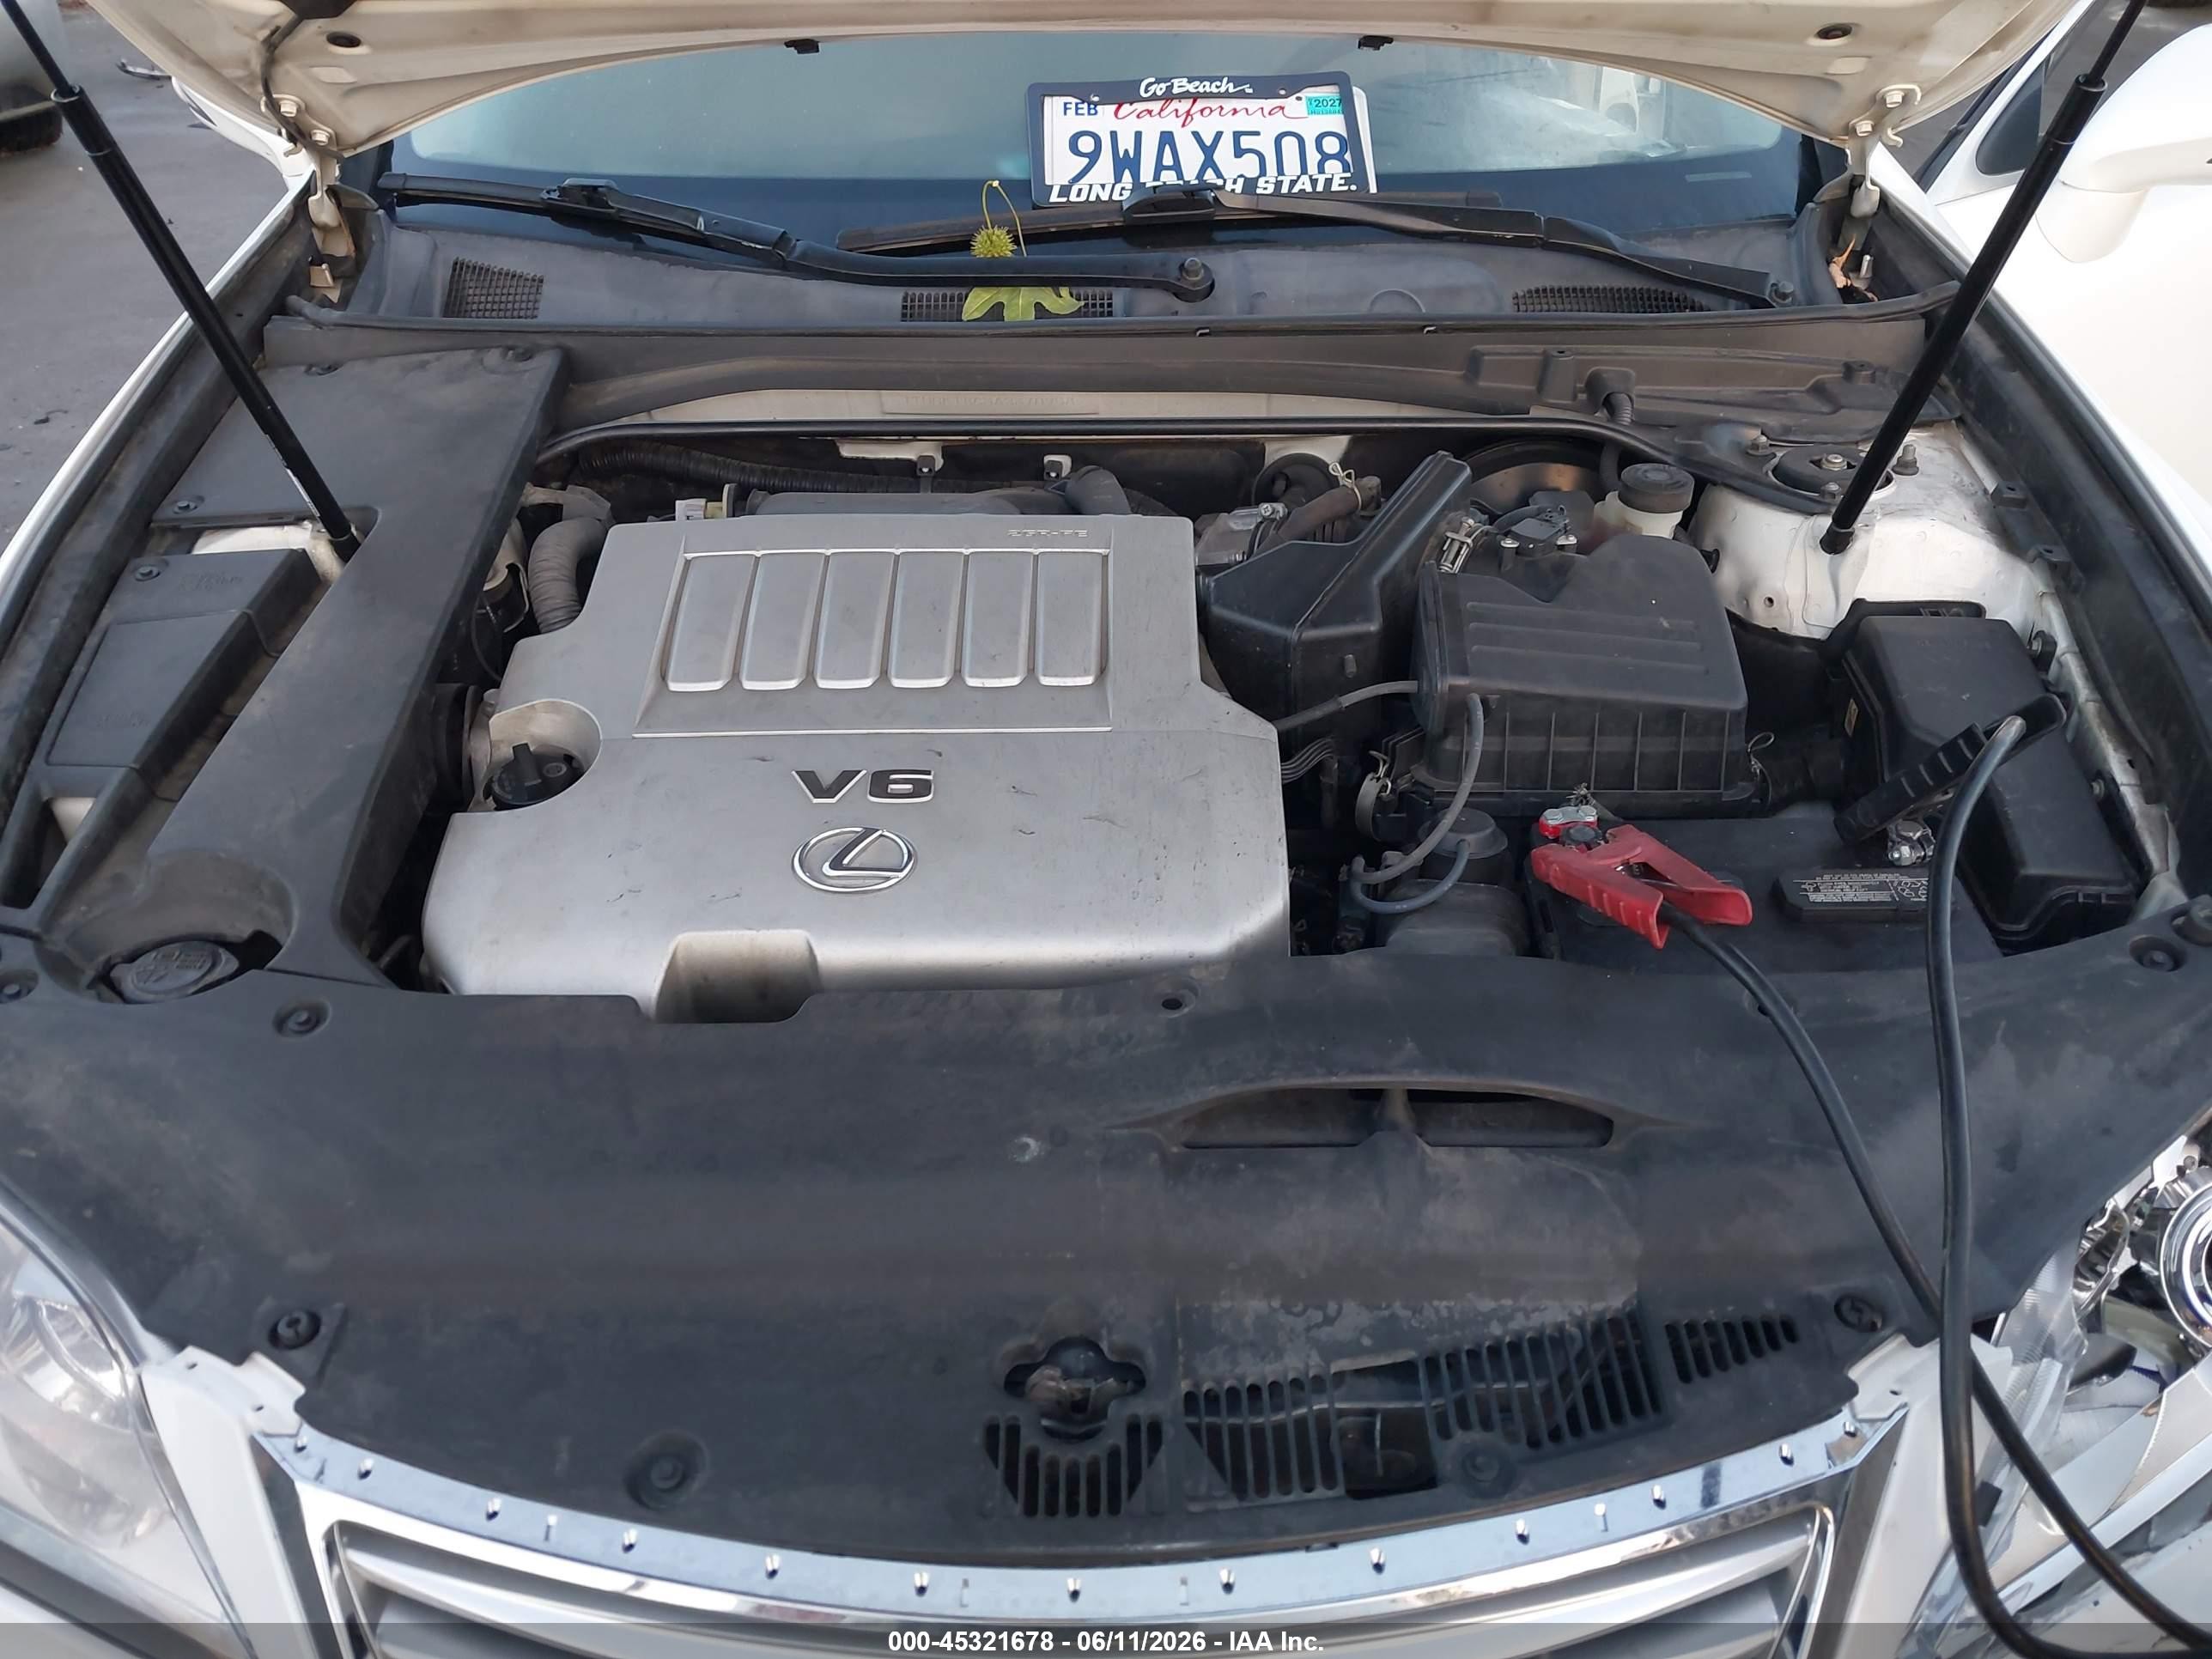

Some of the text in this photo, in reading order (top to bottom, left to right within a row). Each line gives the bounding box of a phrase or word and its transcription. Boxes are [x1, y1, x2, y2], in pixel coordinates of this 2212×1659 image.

[1139, 77, 1170, 98] Go
[1314, 98, 1342, 108] 2027
[1063, 101, 1098, 116] FEB
[1113, 96, 1309, 128] California
[1068, 130, 1350, 184] 9WAX508
[1048, 182, 1133, 204] LONG
[1255, 172, 1358, 195] STATE.
[791, 769, 934, 804] V6
